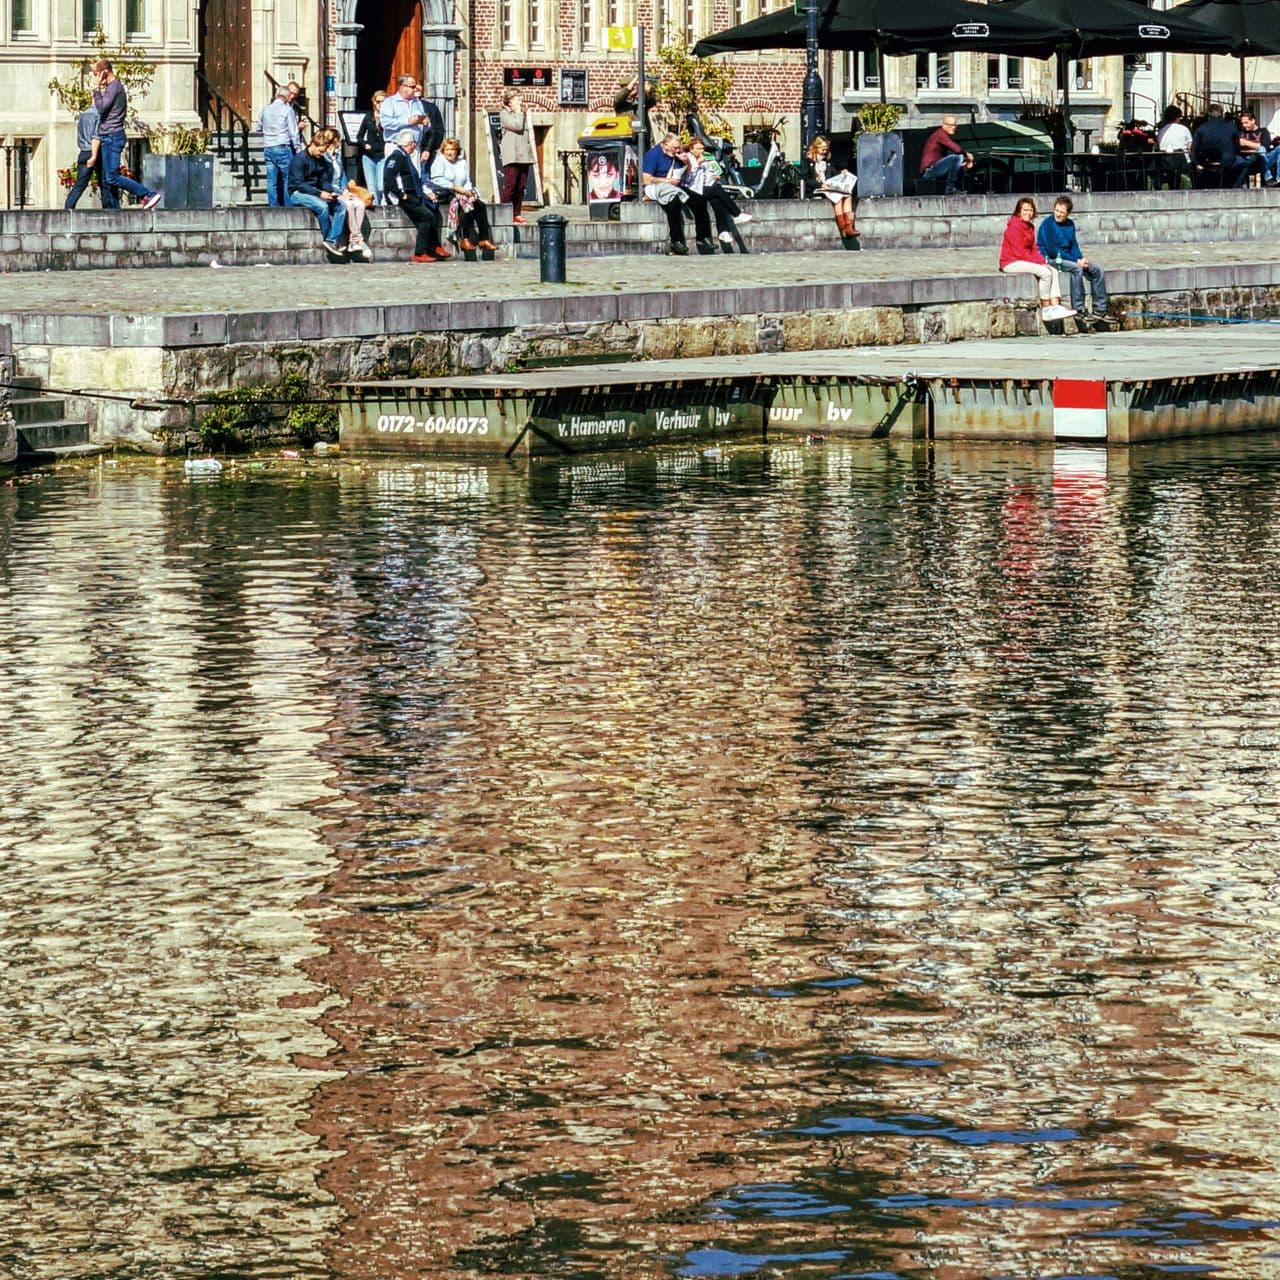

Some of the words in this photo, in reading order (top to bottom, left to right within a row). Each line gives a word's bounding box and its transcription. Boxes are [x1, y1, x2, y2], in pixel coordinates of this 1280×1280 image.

[557, 422, 568, 438] v.
[570, 416, 626, 437] Hameren
[655, 410, 701, 431] Verhuur
[715, 406, 731, 426] bv
[826, 401, 853, 422] bv
[377, 414, 489, 435] 0172-604073
